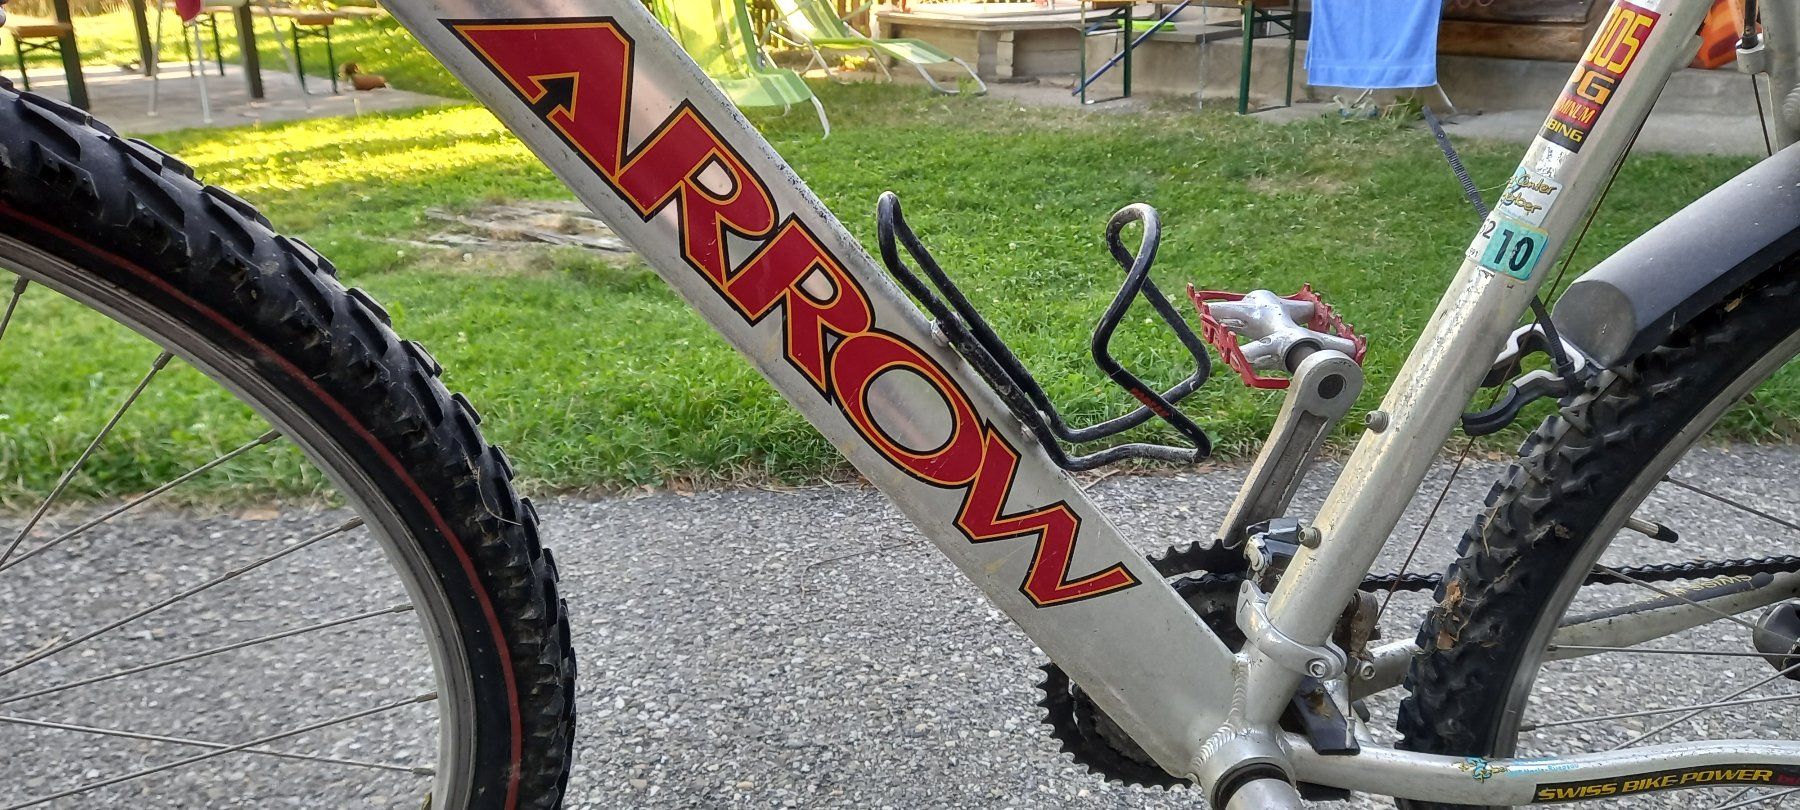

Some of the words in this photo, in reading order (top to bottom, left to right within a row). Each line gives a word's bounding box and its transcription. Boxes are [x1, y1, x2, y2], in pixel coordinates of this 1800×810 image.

[1493, 229, 1535, 272] 10
[438, 17, 1141, 608] ARROW
[1537, 783, 1618, 801] SWISS
[1621, 775, 1679, 793] BIKE
[1680, 769, 1773, 784] POWER
